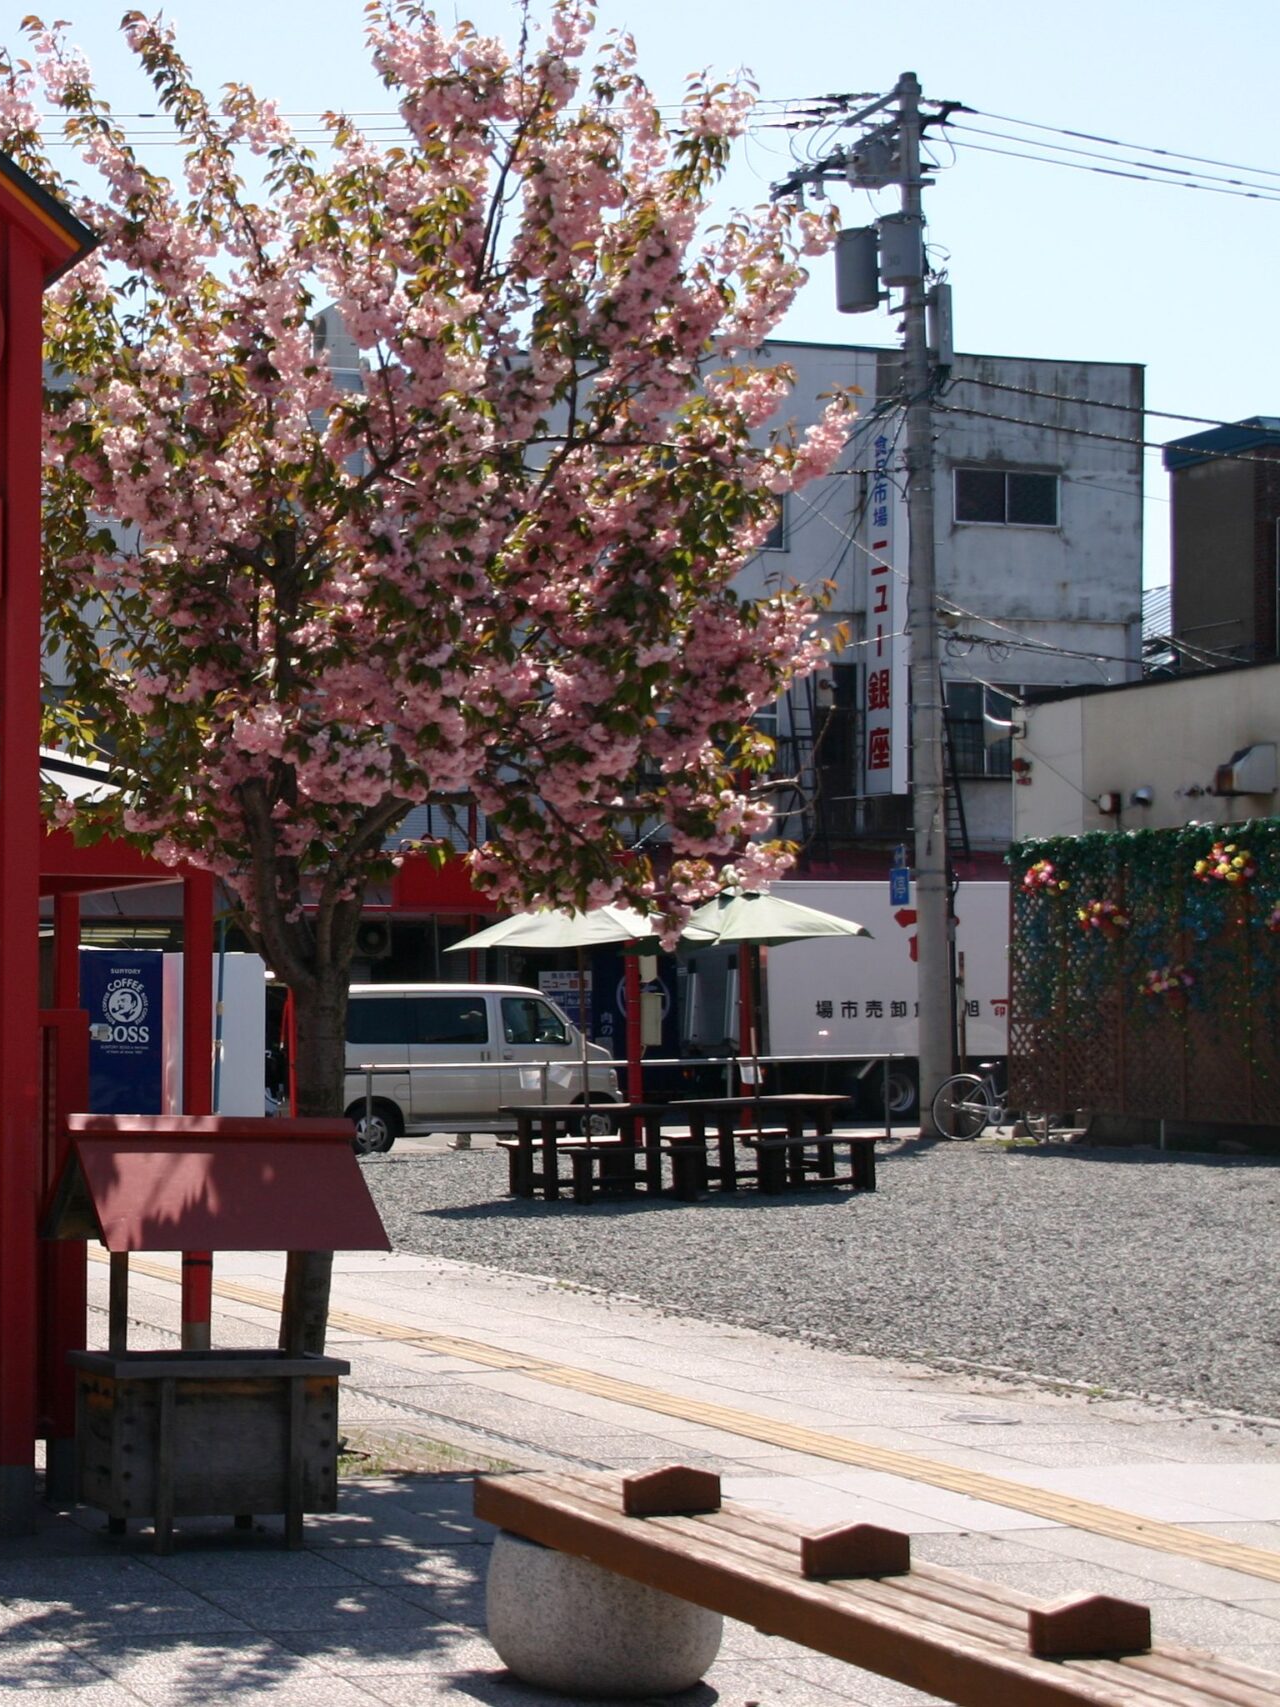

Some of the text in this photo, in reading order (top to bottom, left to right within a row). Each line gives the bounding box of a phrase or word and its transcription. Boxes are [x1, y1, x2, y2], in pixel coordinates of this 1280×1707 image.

[867, 540, 890, 771] ニュー銀座
[107, 978, 145, 993] COFFEE
